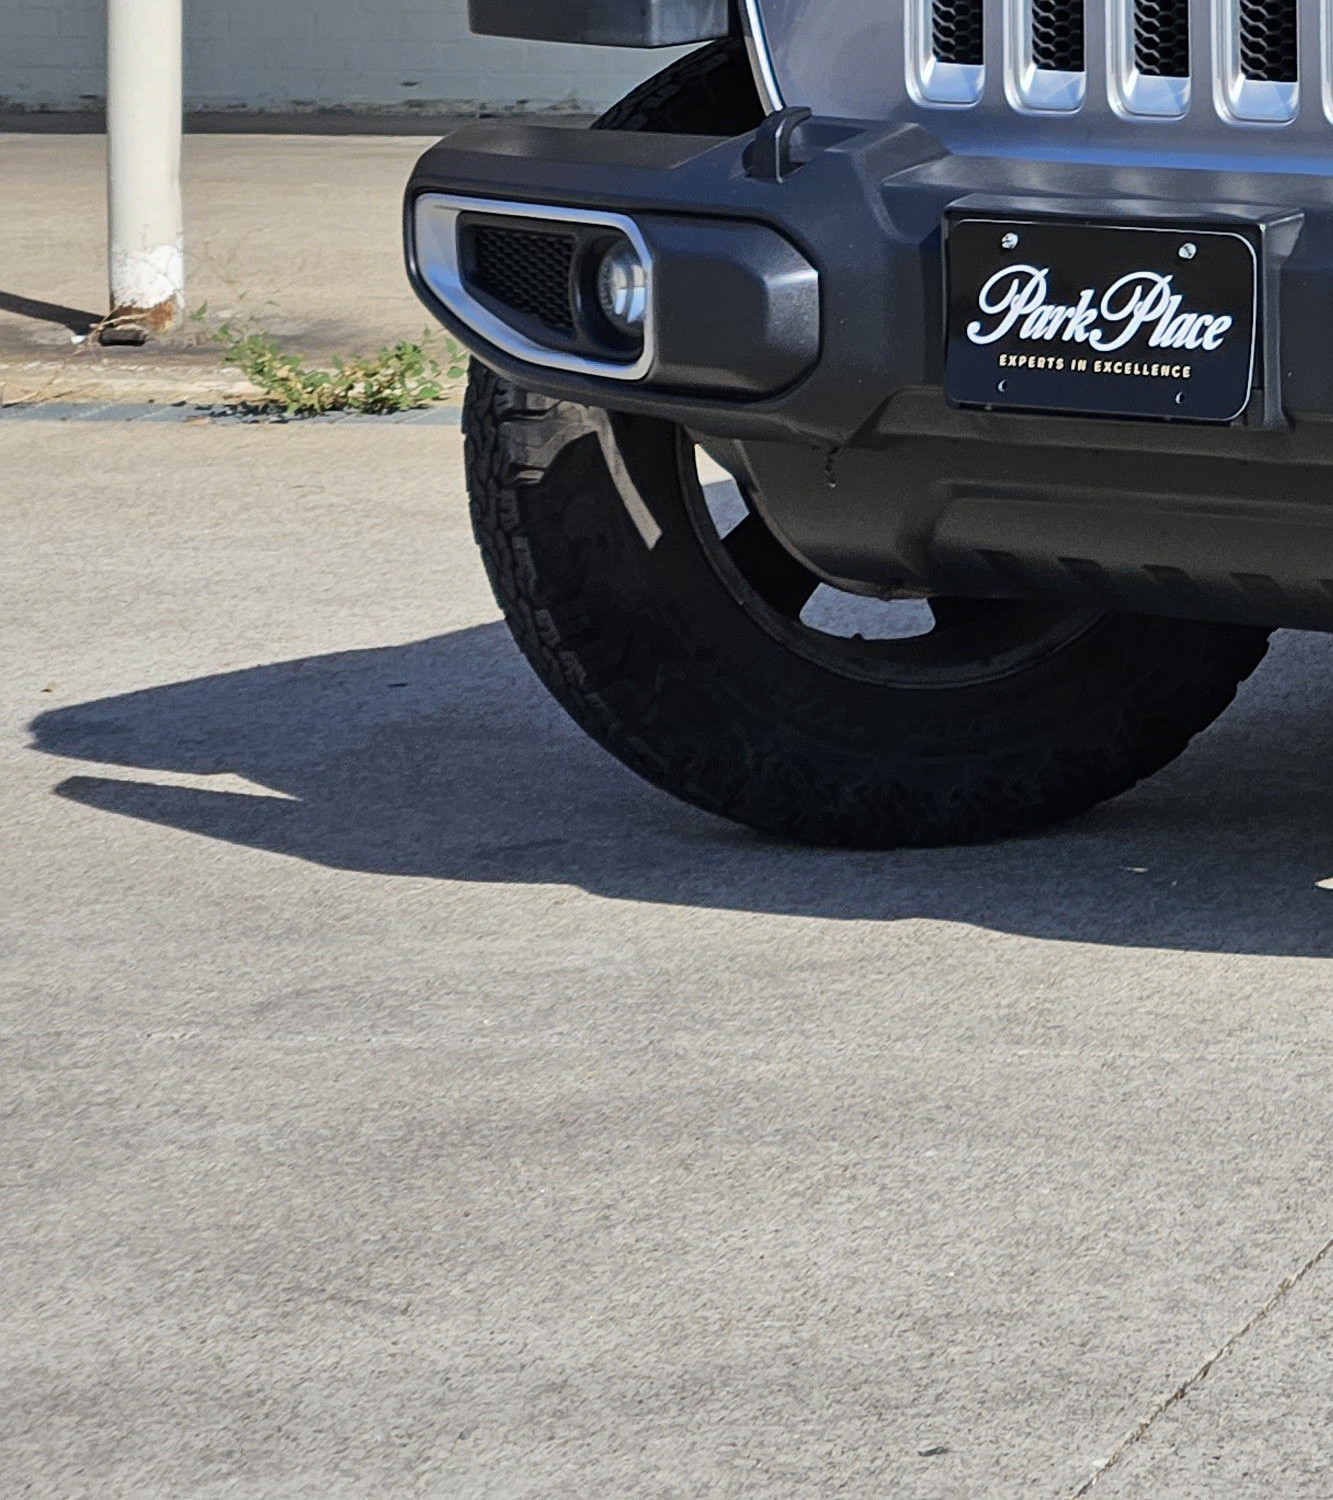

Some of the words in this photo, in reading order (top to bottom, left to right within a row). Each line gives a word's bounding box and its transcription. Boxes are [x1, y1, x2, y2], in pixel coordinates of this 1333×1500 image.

[967, 264, 1098, 345] Park
[1088, 271, 1233, 352] Place
[999, 354, 1065, 371] EXPERTS
[1071, 359, 1088, 373] IN
[1093, 360, 1192, 379] EXCELLENCE
